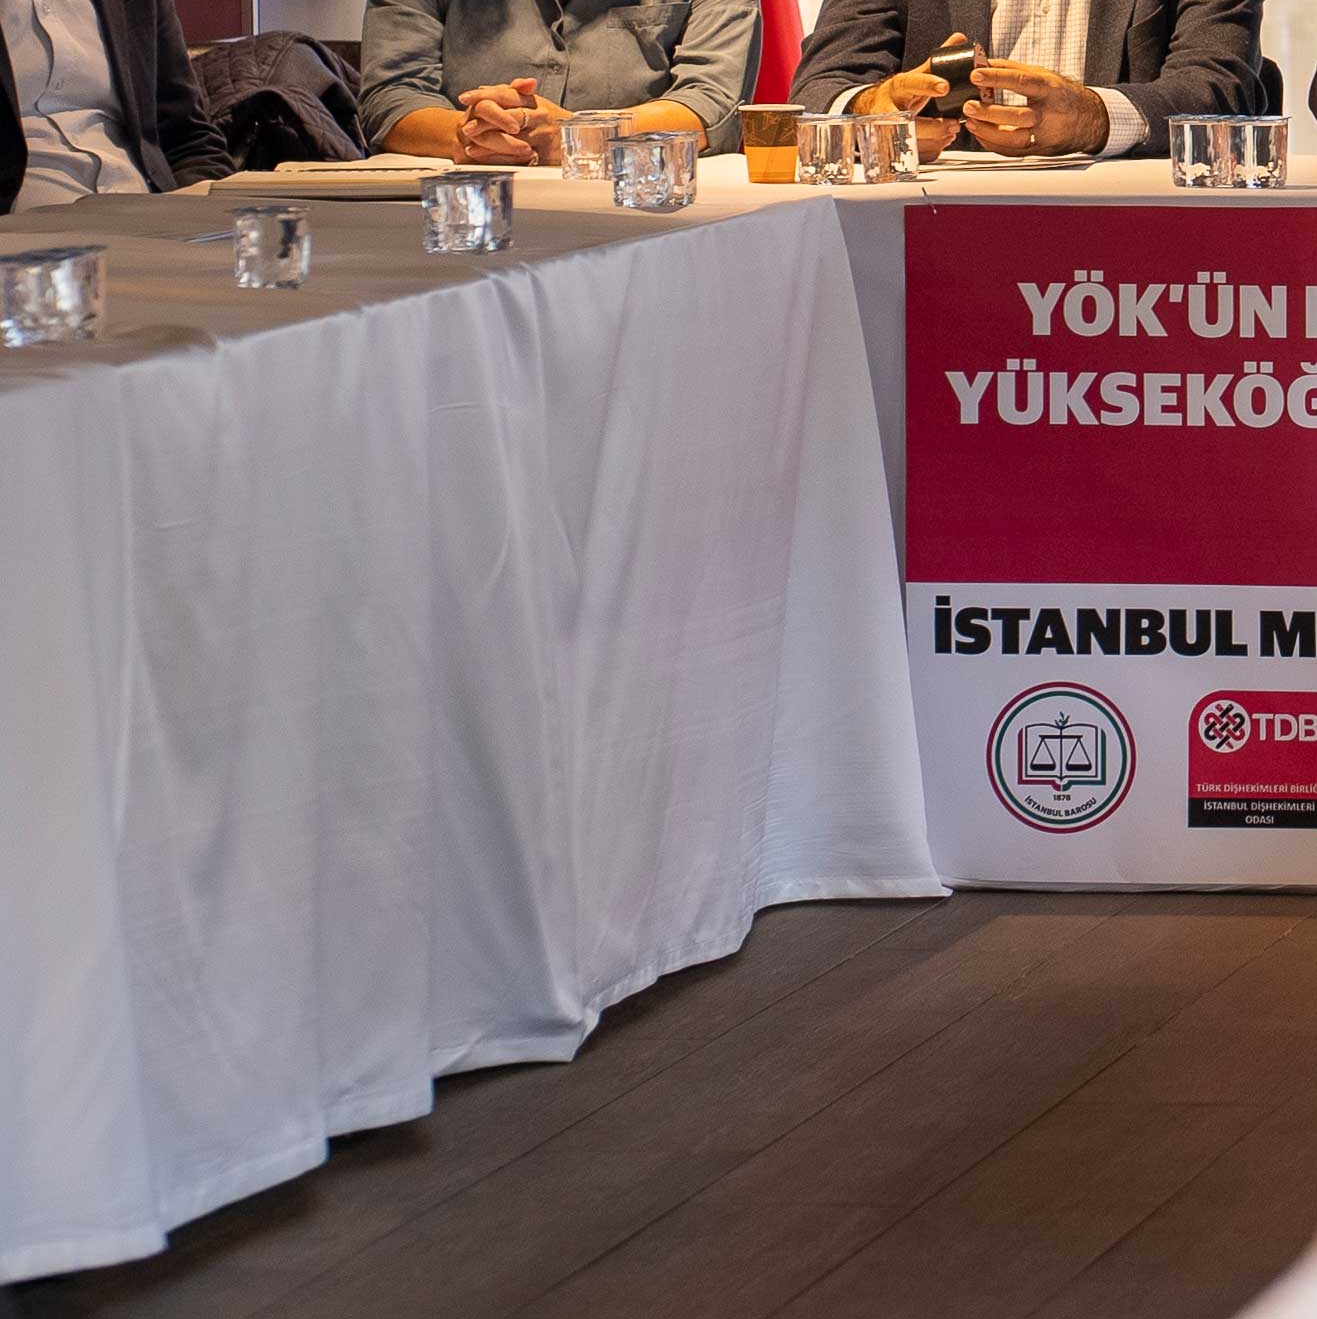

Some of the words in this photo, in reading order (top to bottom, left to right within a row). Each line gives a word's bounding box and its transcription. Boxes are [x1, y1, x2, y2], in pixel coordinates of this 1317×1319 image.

[1016, 269, 1288, 339] YÖK'ÜN
[934, 595, 1248, 657] İSTANBUL
[1196, 782, 1222, 792] TÜRK
[1024, 794, 1064, 817] İSTANBUL
[1064, 796, 1098, 817] BAROSU
[1203, 800, 1249, 811] İSTANBUL
[1245, 815, 1274, 824] ODASI
